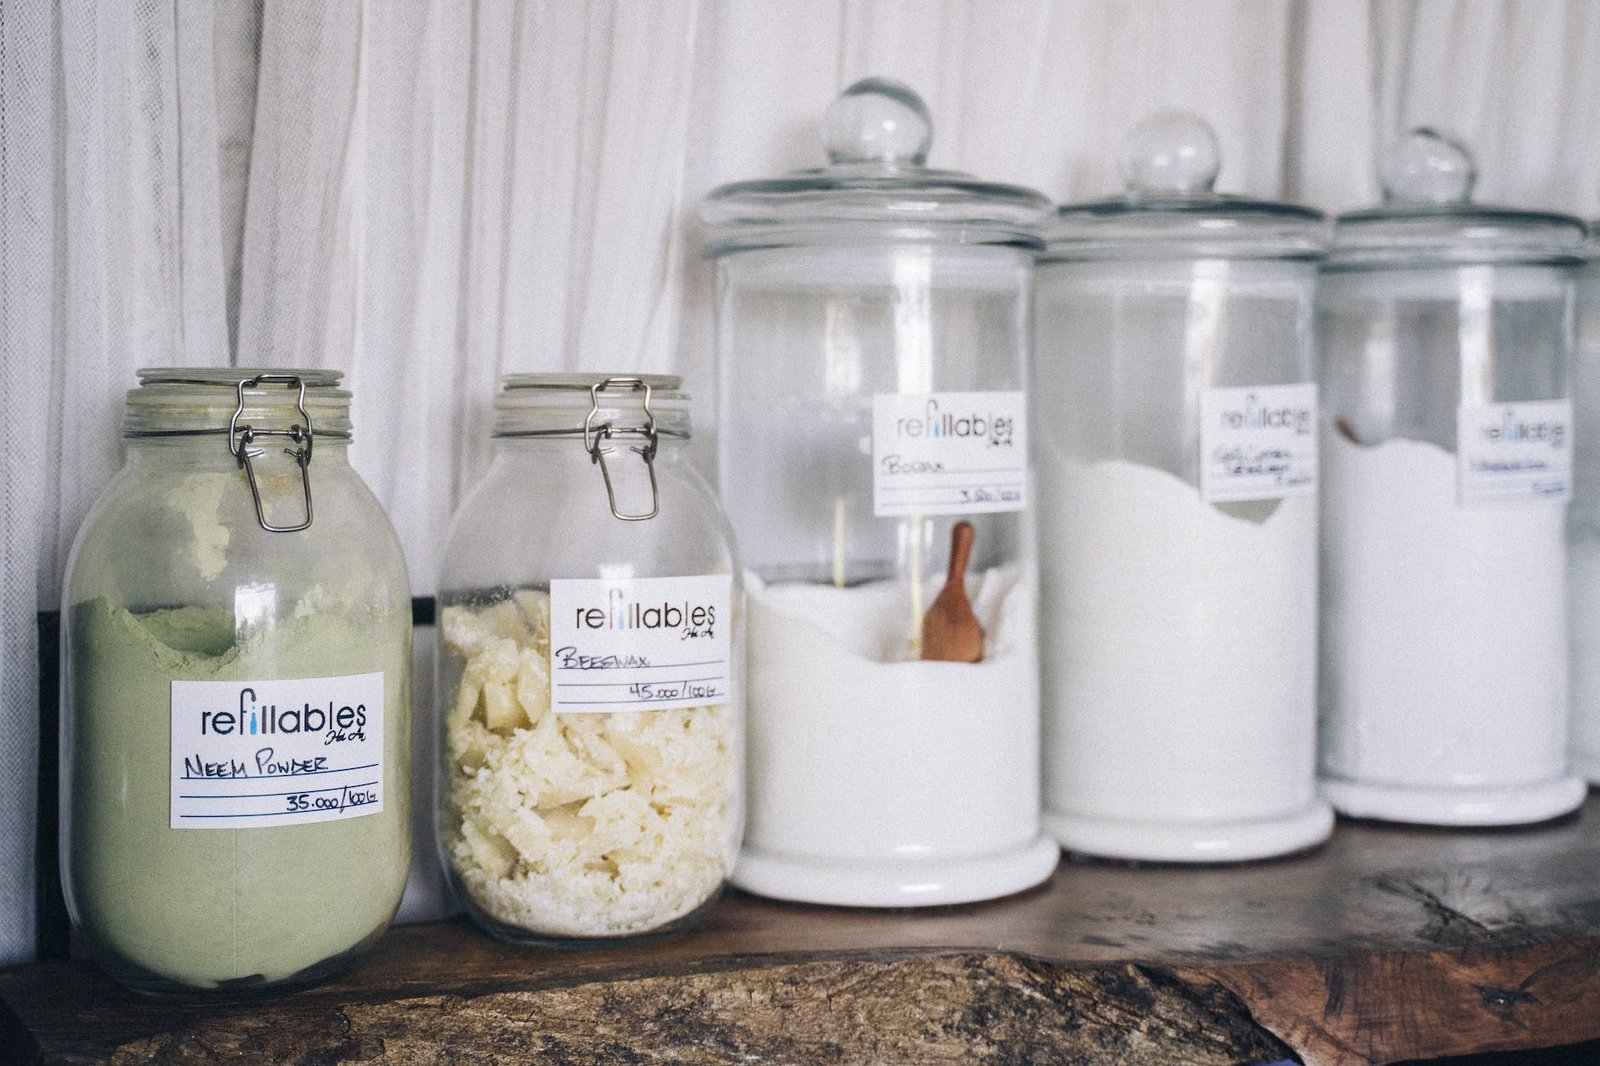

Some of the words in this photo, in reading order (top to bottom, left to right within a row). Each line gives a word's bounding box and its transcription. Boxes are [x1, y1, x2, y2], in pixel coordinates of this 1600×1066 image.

[897, 399, 1013, 438] refillables
[576, 588, 715, 630] refillables
[201, 687, 367, 736] refillables
[184, 753, 248, 779] NEEM
